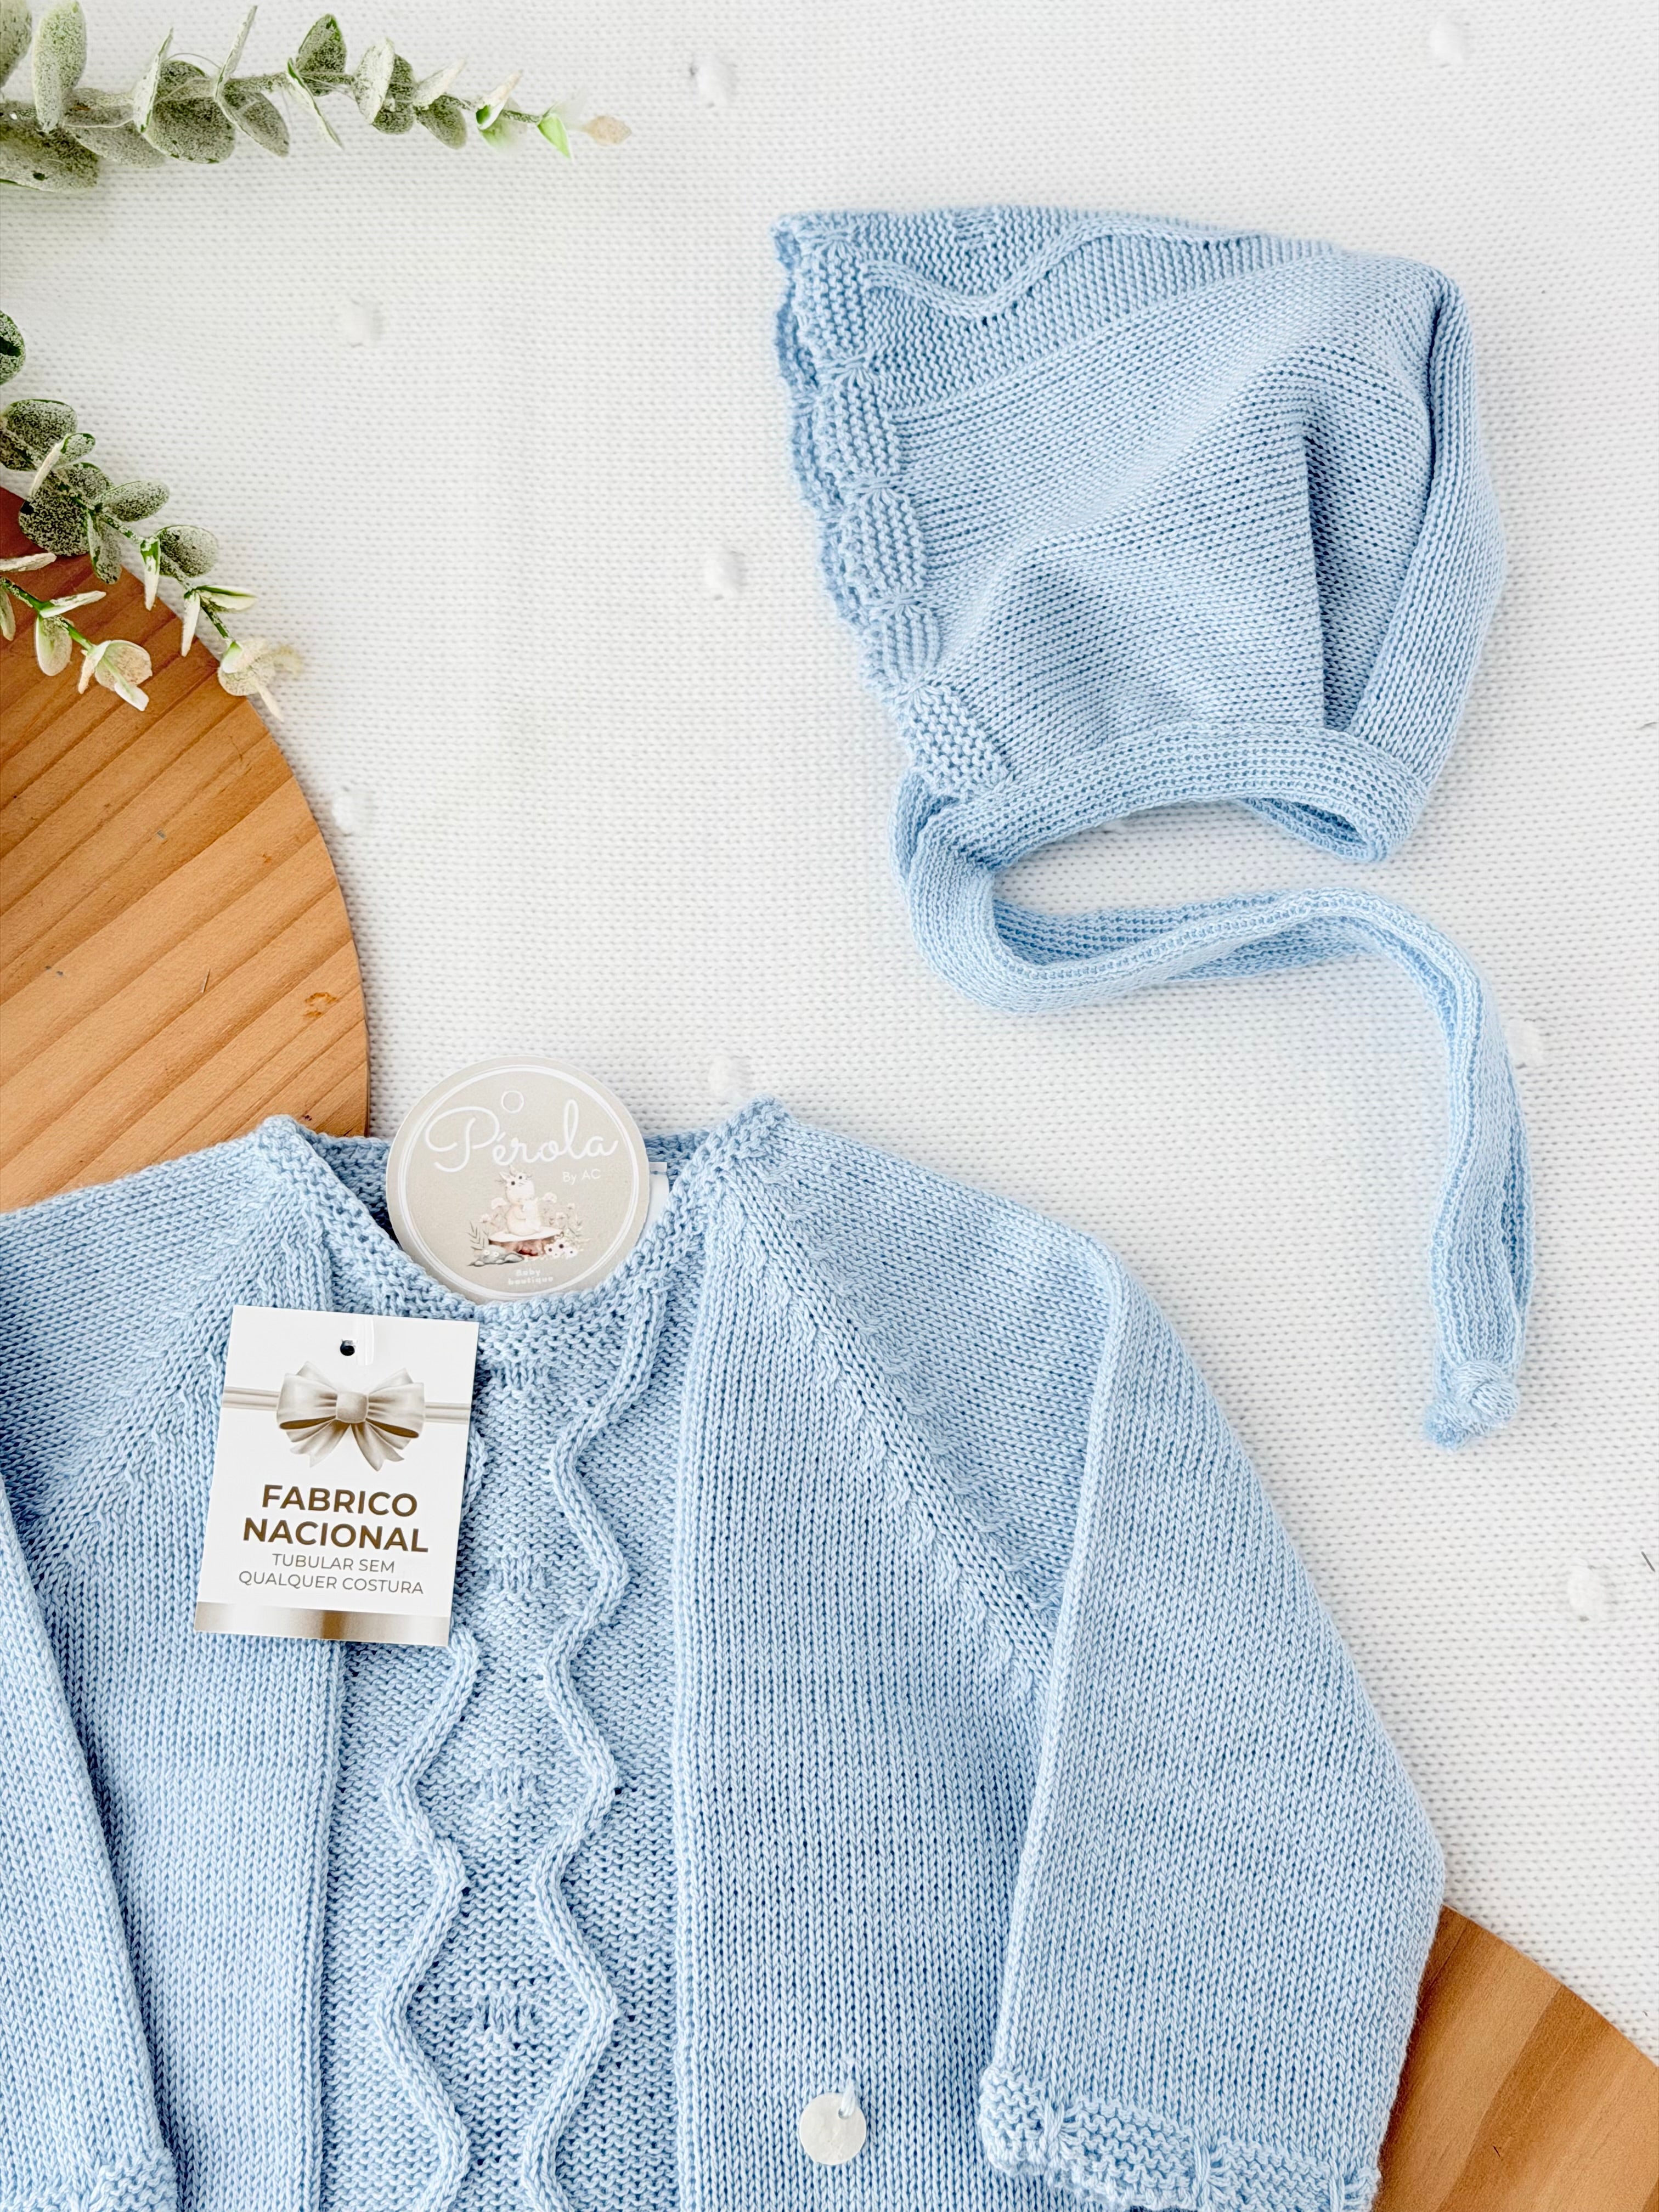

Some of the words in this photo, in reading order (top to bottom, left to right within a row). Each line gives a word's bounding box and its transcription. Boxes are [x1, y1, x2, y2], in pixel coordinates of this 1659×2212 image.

[425, 1099, 618, 1172] Pérola
[562, 1171, 577, 1186] By
[581, 1169, 601, 1180] AC
[262, 1484, 417, 1517] FABRICO
[242, 1517, 429, 1553] NACIONAL
[272, 1553, 353, 1571] TUBULAR
[358, 1560, 395, 1574] SEM
[239, 1571, 336, 1590] QUALQUER
[342, 1578, 424, 1595] COSTURA
